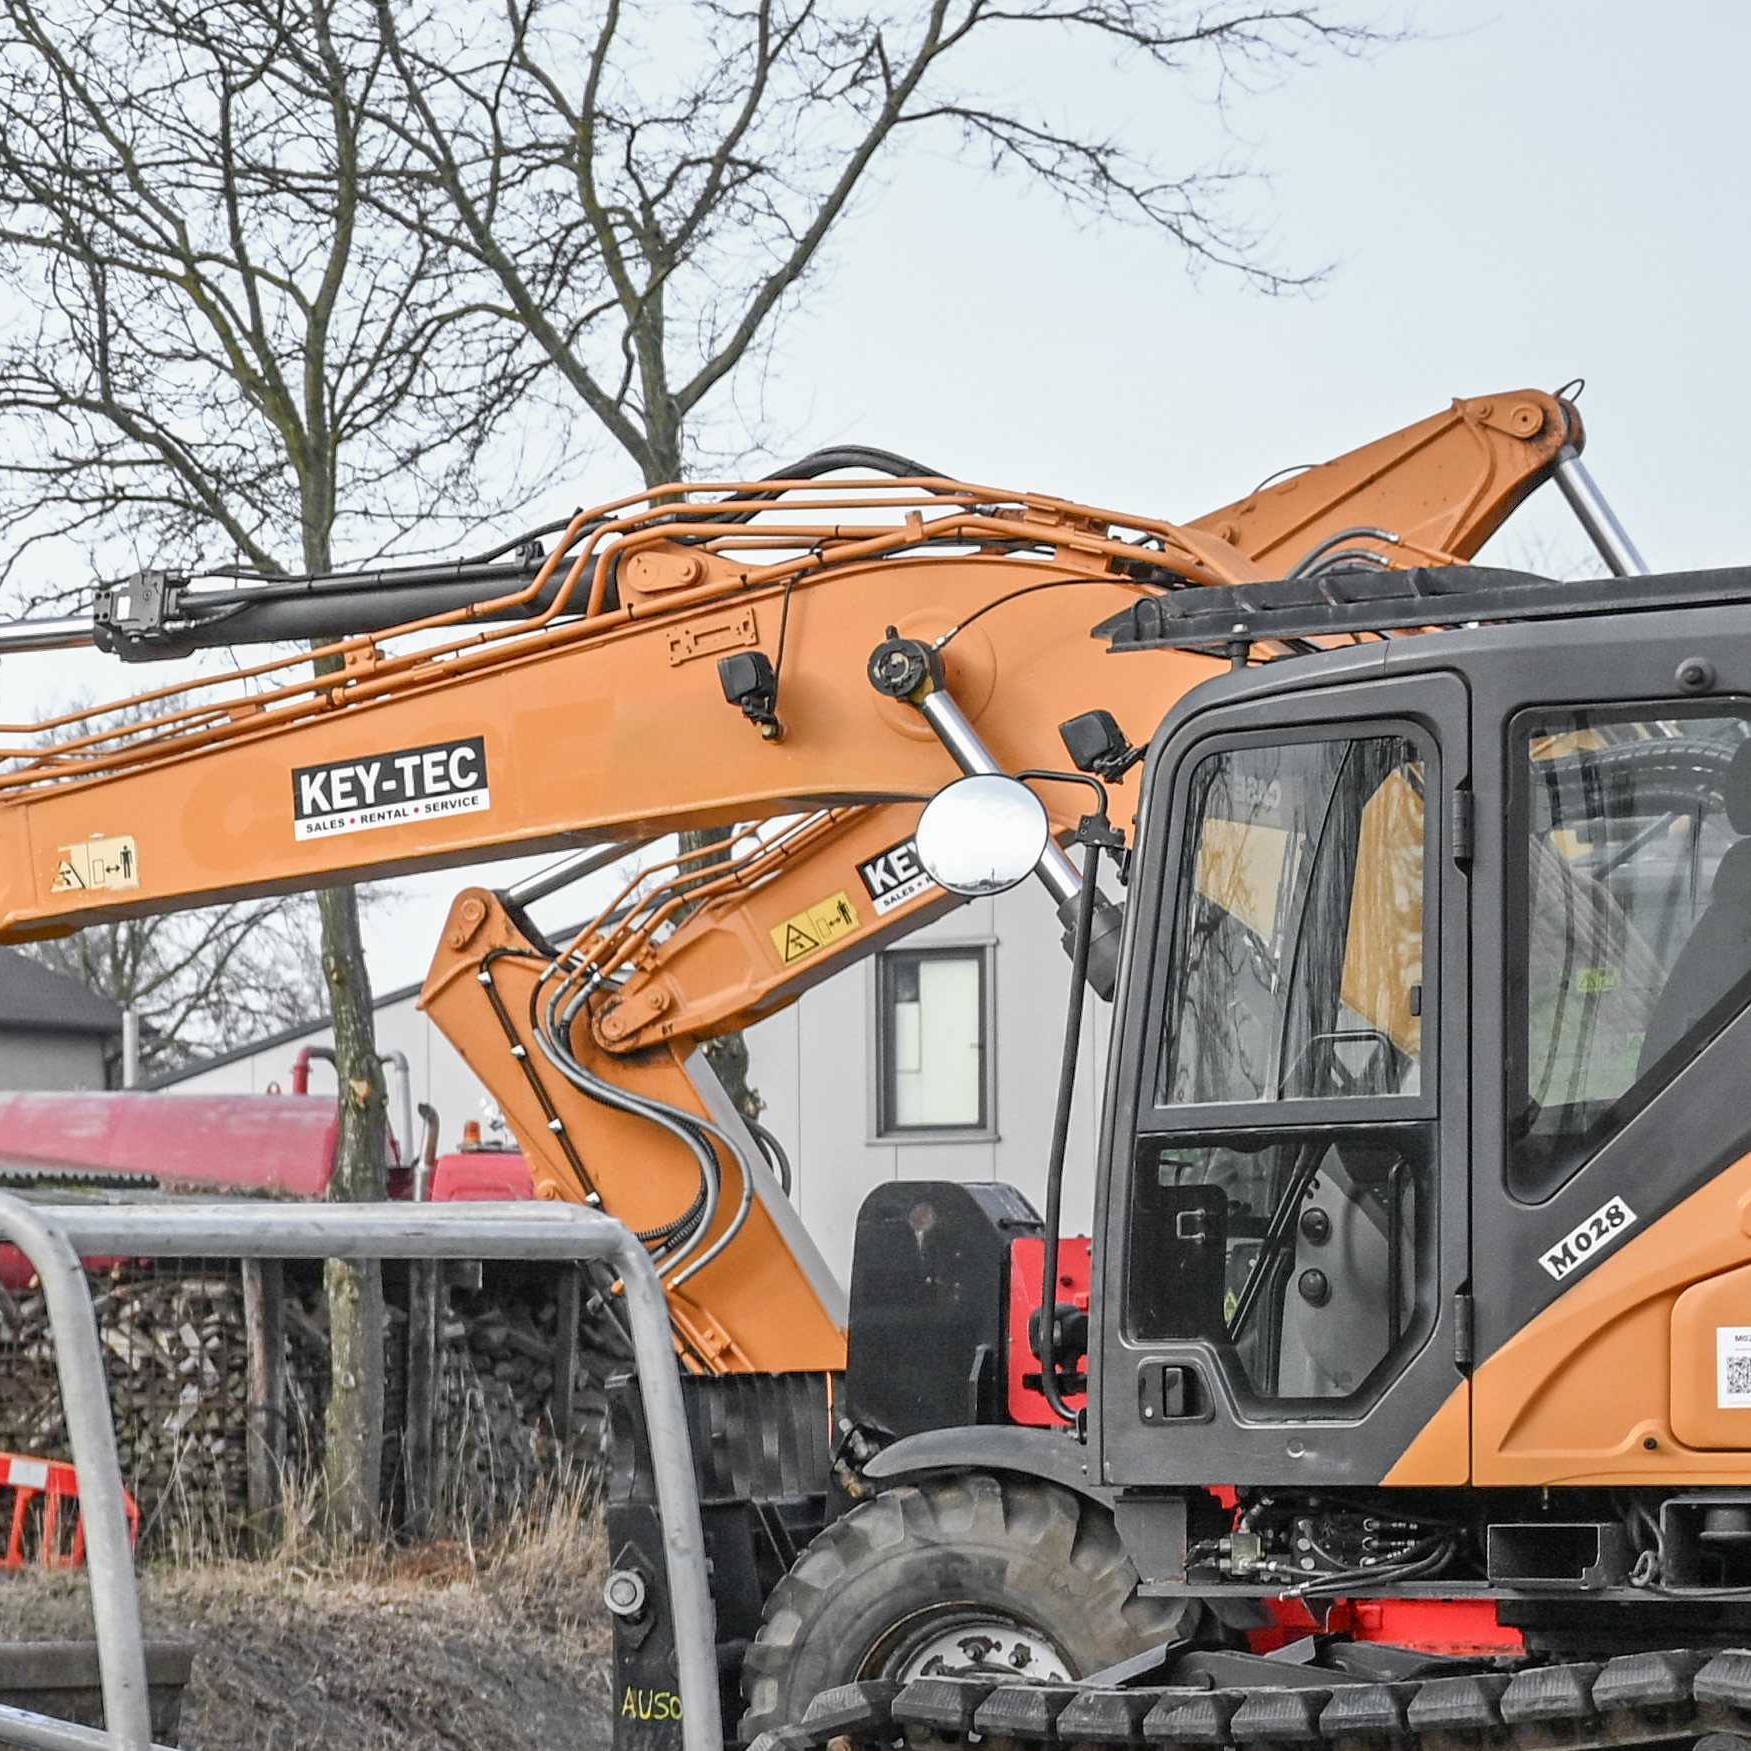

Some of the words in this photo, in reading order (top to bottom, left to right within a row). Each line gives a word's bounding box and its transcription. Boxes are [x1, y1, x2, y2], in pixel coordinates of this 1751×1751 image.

[299, 746, 479, 815] KEY-TEC
[306, 817, 345, 834] SALES
[360, 808, 409, 825] RENTAL
[424, 795, 479, 813] SERVICE
[883, 885, 916, 907] SALES
[1547, 1204, 1626, 1277] M028
